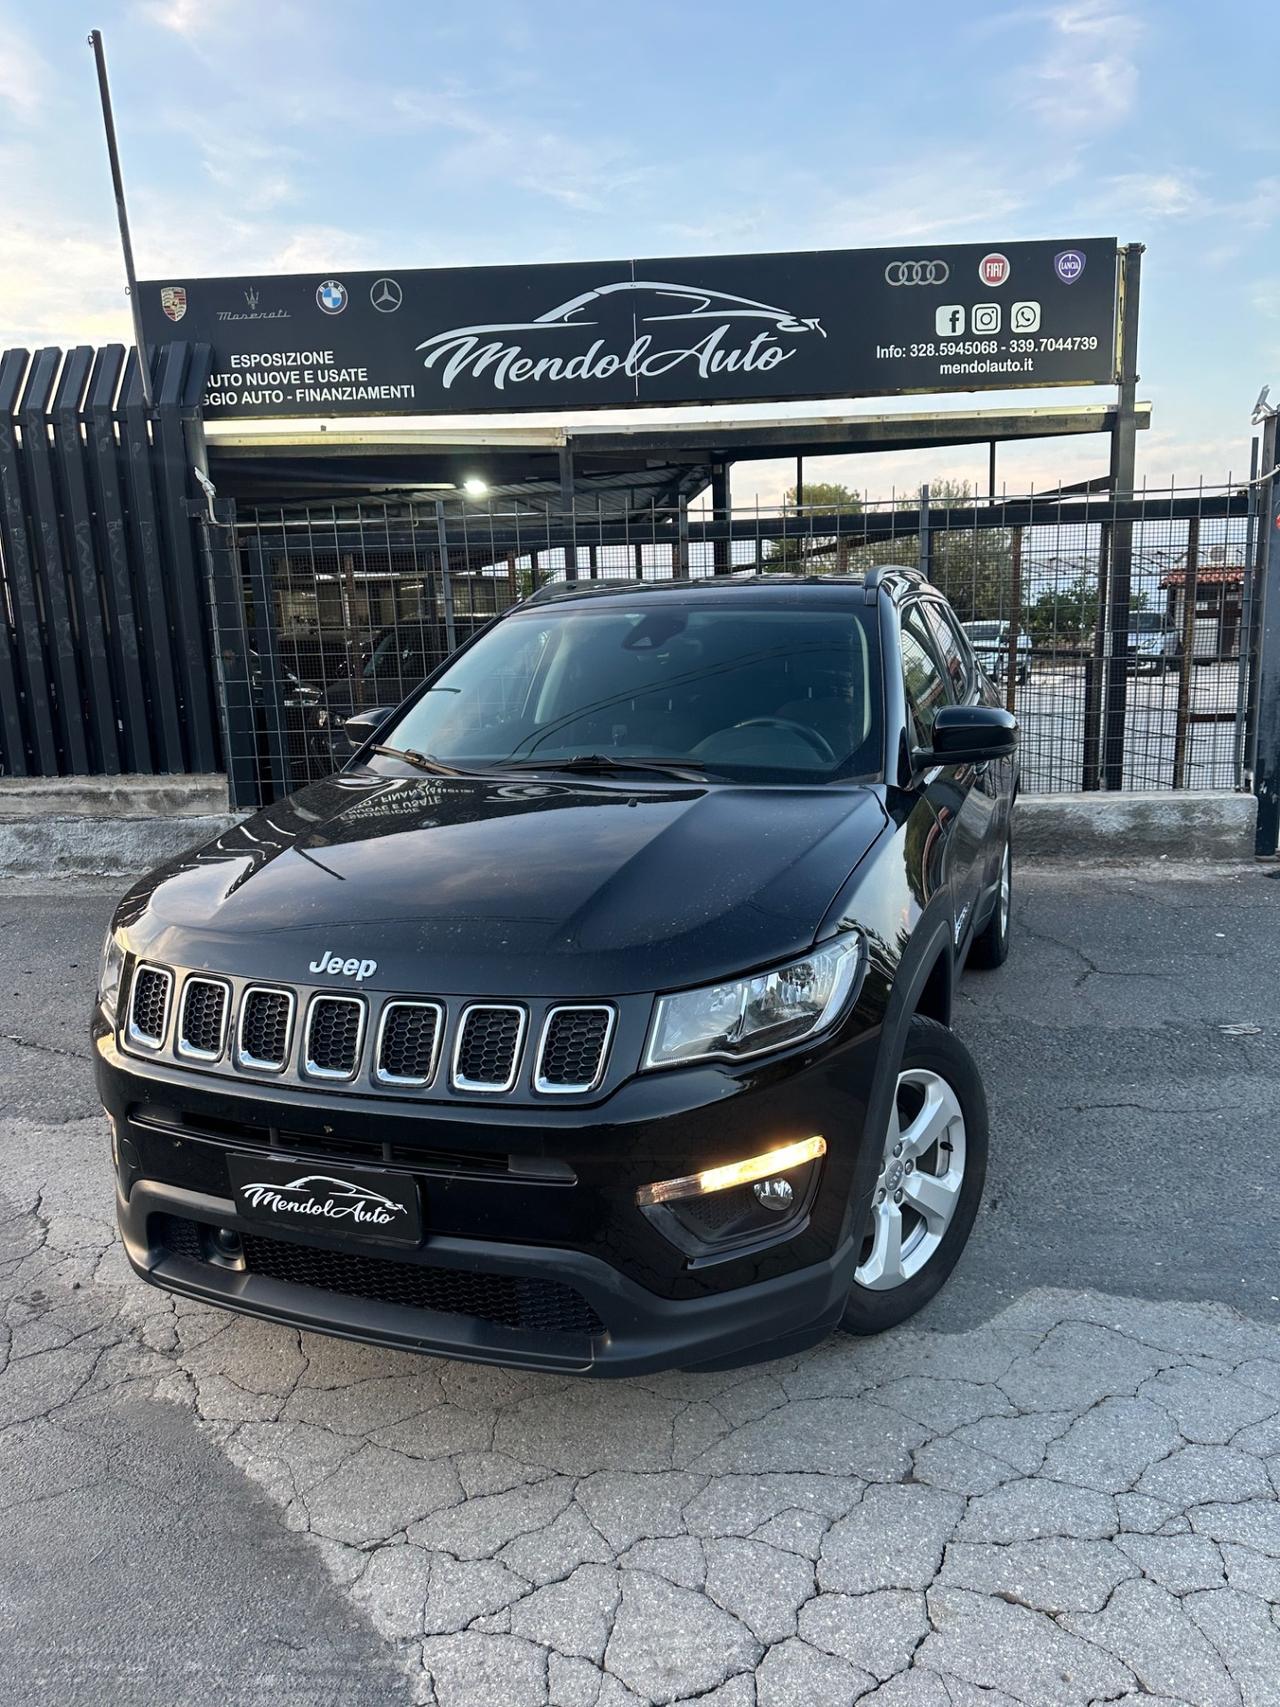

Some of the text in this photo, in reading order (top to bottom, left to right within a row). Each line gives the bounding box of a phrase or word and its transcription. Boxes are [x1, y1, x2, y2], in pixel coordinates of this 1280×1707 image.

[985, 262, 1004, 278] FIAT
[1060, 261, 1079, 271] LANCIA
[319, 281, 344, 293] BMW
[216, 309, 292, 321] Maserati
[876, 345, 907, 359] Info:
[1009, 337, 1098, 353] 339.7044739
[230, 350, 335, 368] ESPOSIZIONE
[940, 357, 1034, 375] mendolauto.it
[246, 370, 301, 386] NUOVE
[304, 370, 315, 384] E
[318, 367, 369, 383] USATE
[241, 389, 284, 405] AUTO
[296, 384, 416, 403] FINANZIAMENTI
[309, 951, 379, 981] Jeep
